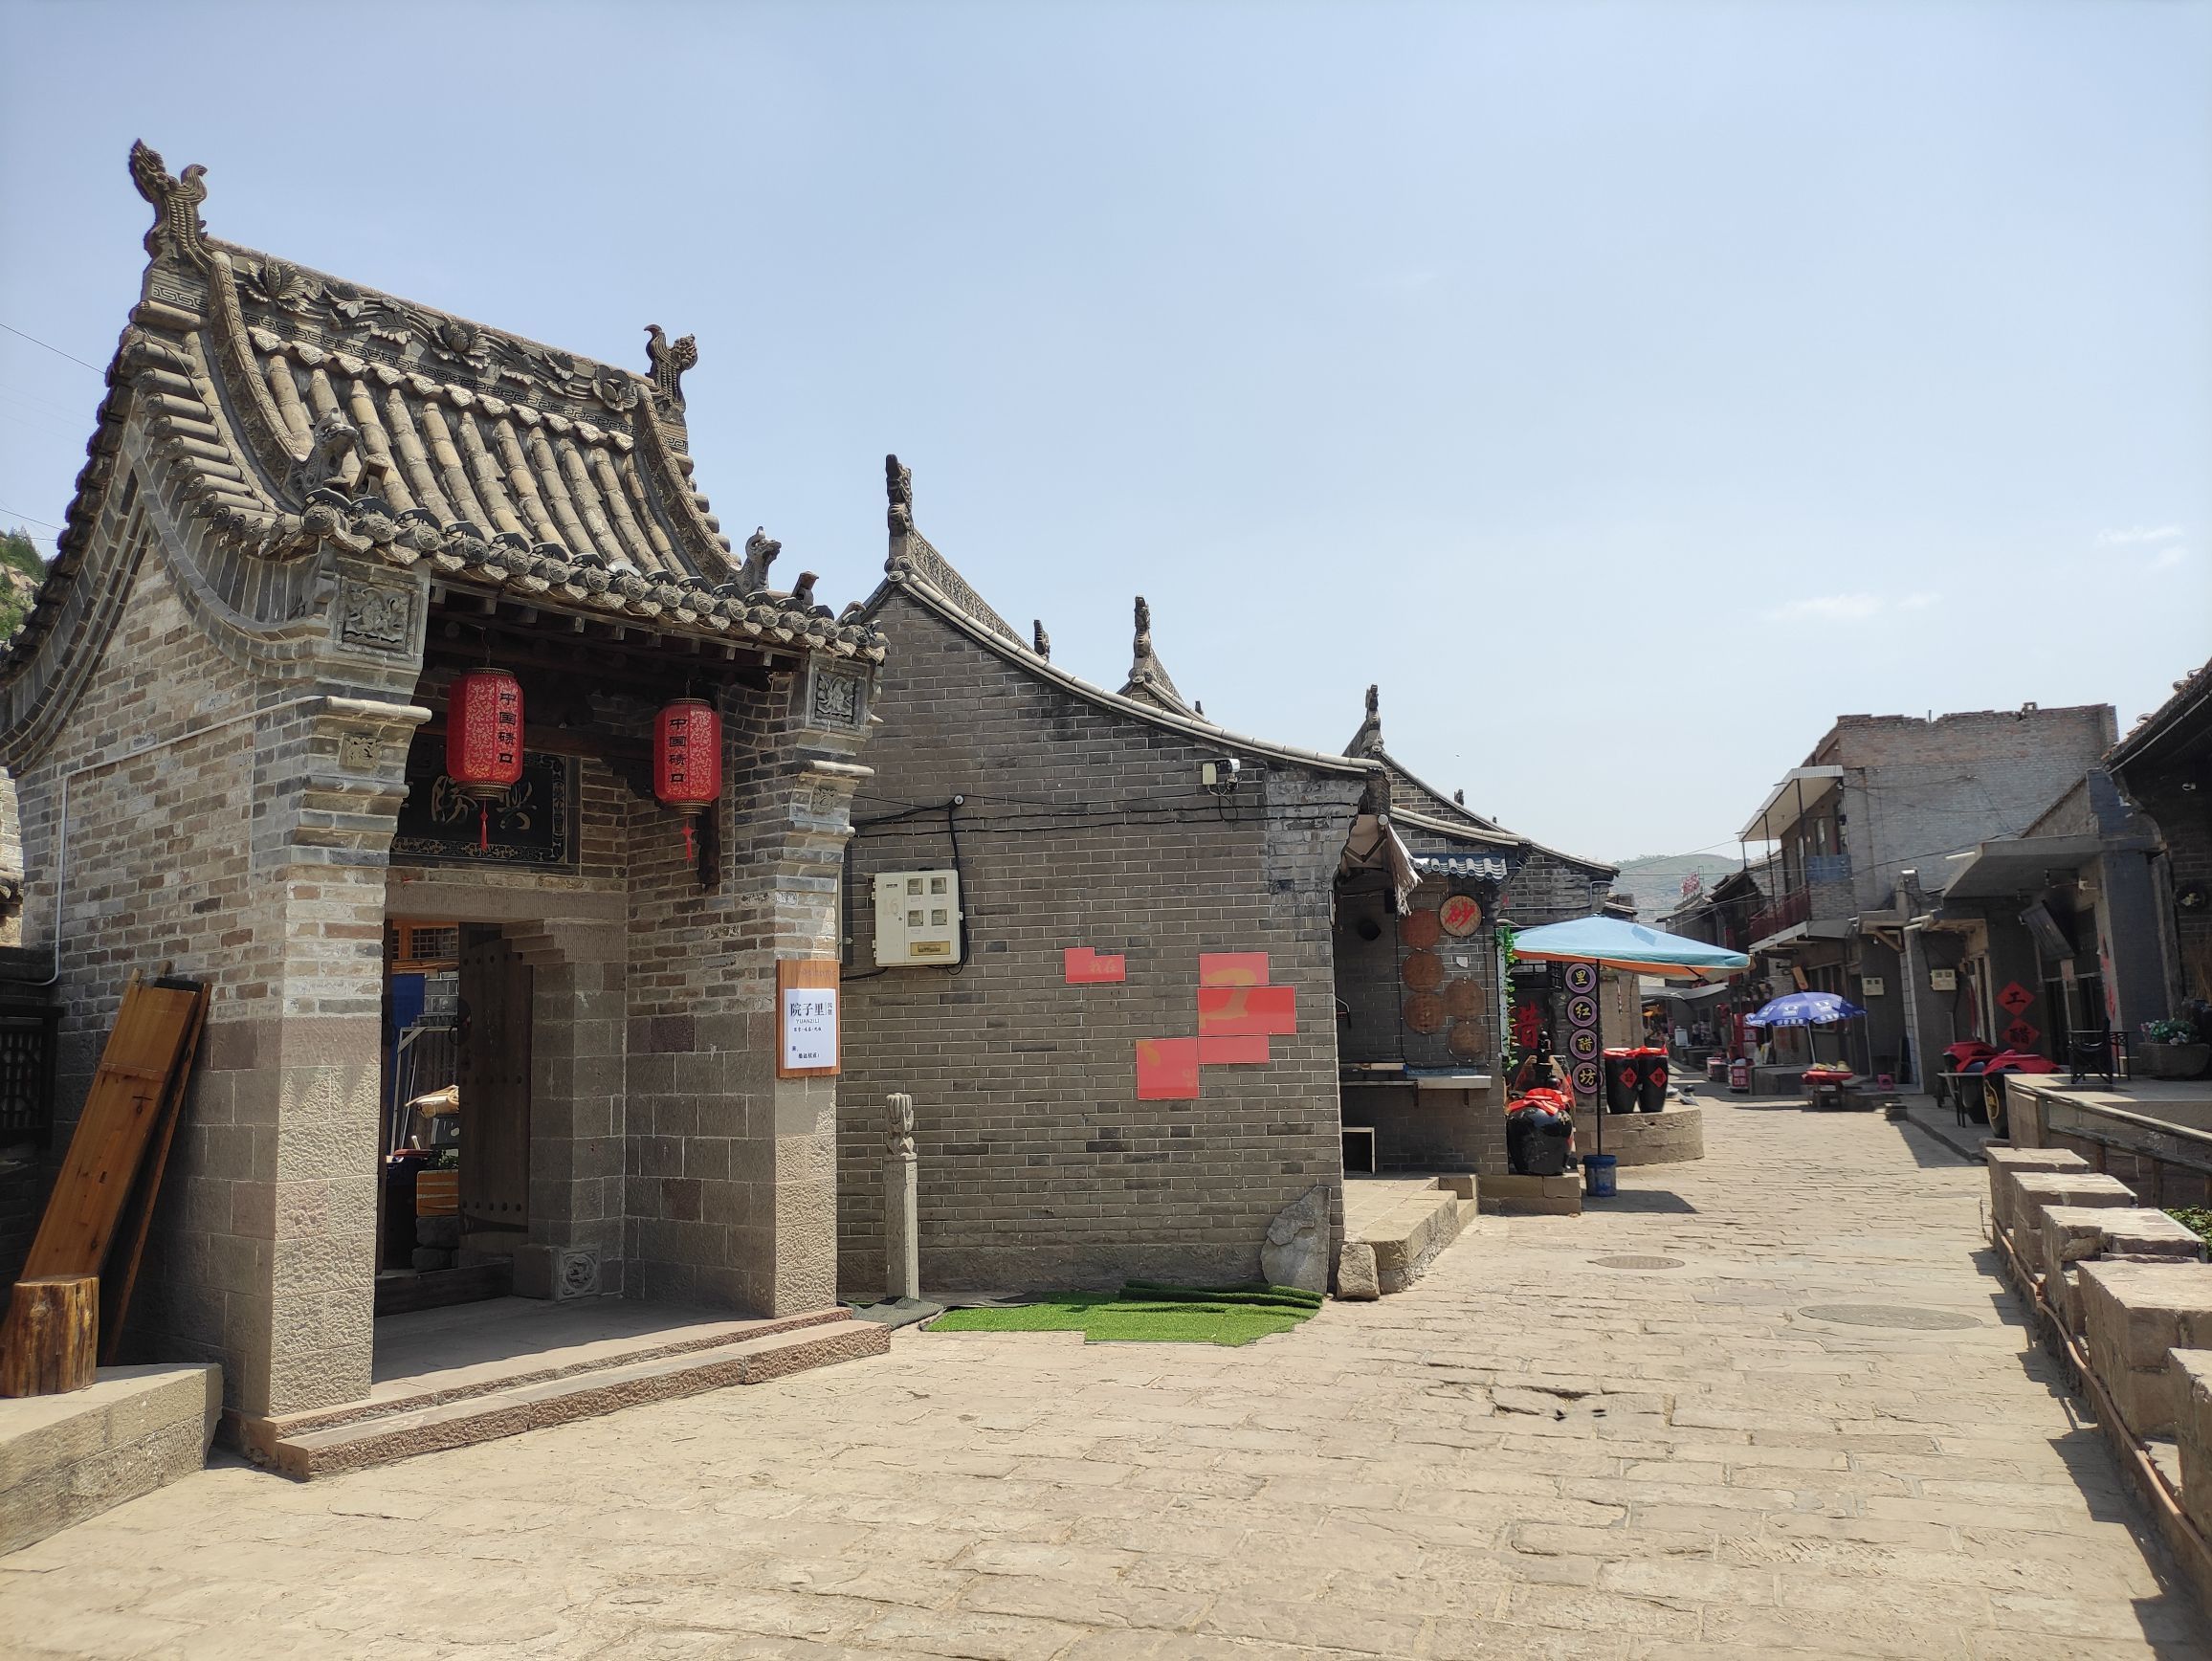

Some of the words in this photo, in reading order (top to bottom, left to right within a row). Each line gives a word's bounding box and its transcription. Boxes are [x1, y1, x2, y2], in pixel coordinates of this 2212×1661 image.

[498, 692, 518, 764] 中国碛口
[669, 719, 688, 782] 中国碛口
[790, 1003, 824, 1016] 院子里
[1575, 969, 1597, 1089] 里红醋坊
